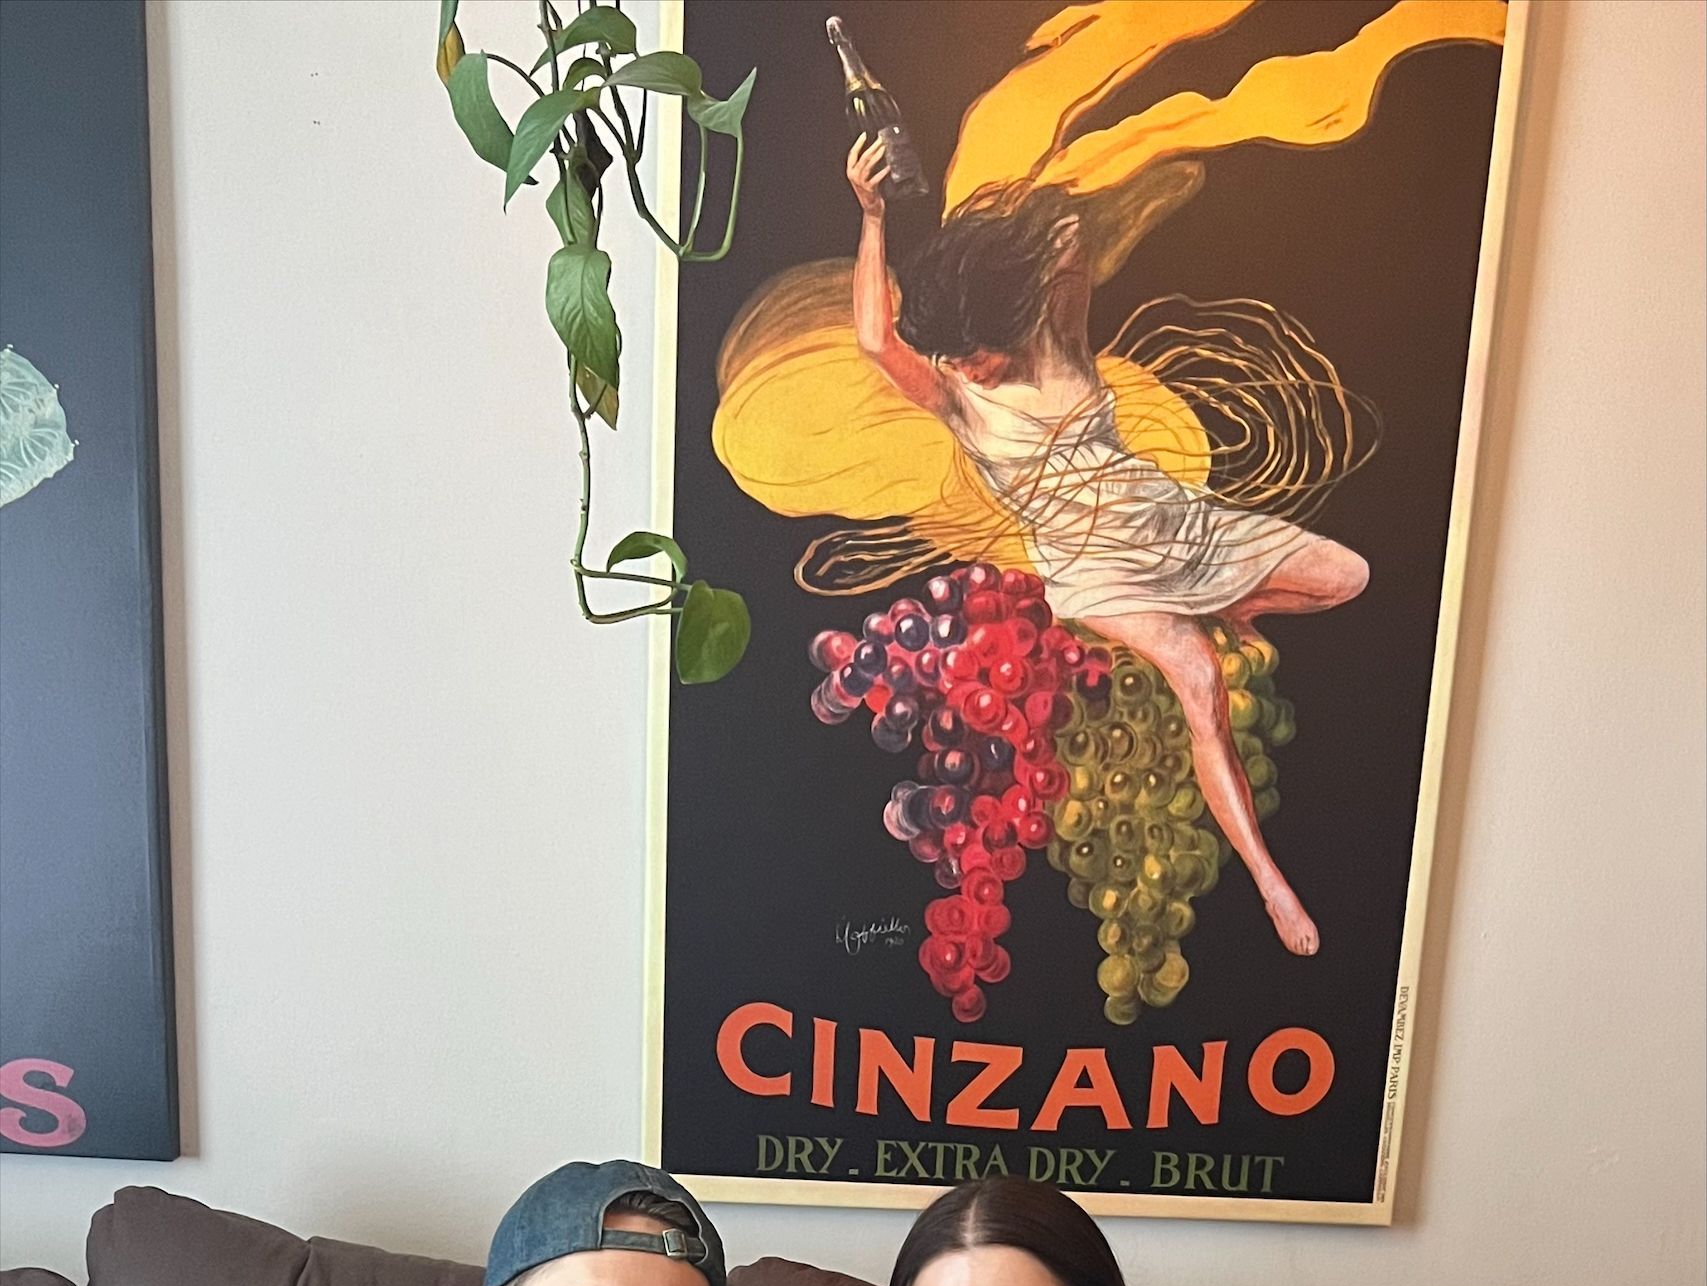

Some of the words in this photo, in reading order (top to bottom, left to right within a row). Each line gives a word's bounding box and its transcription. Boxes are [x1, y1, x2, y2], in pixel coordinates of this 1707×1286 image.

[715, 1002, 1336, 1131] CINZANO
[1387, 1065, 1400, 1099] PARIS
[757, 1134, 844, 1173] DRY
[875, 1140, 1009, 1181] EXTRA
[1028, 1146, 1114, 1187] DRY
[1151, 1153, 1285, 1194] BRUT
